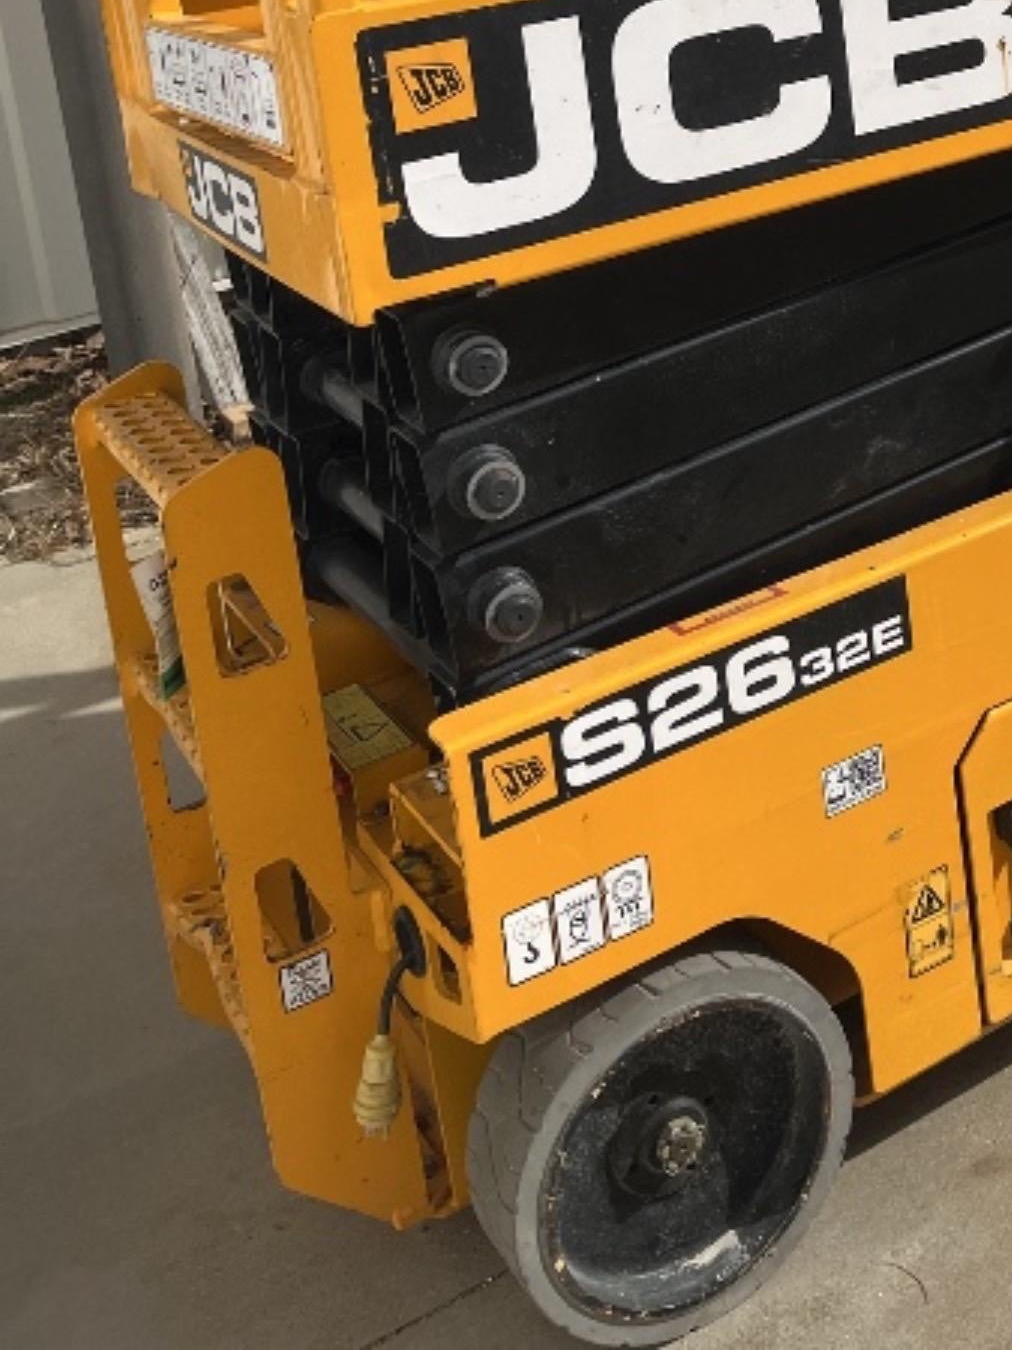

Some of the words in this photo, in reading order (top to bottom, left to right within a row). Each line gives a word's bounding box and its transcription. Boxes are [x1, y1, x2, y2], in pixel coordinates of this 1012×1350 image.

[409, 66, 462, 107] JCB
[188, 154, 265, 254] JCB
[501, 754, 546, 796] JCB
